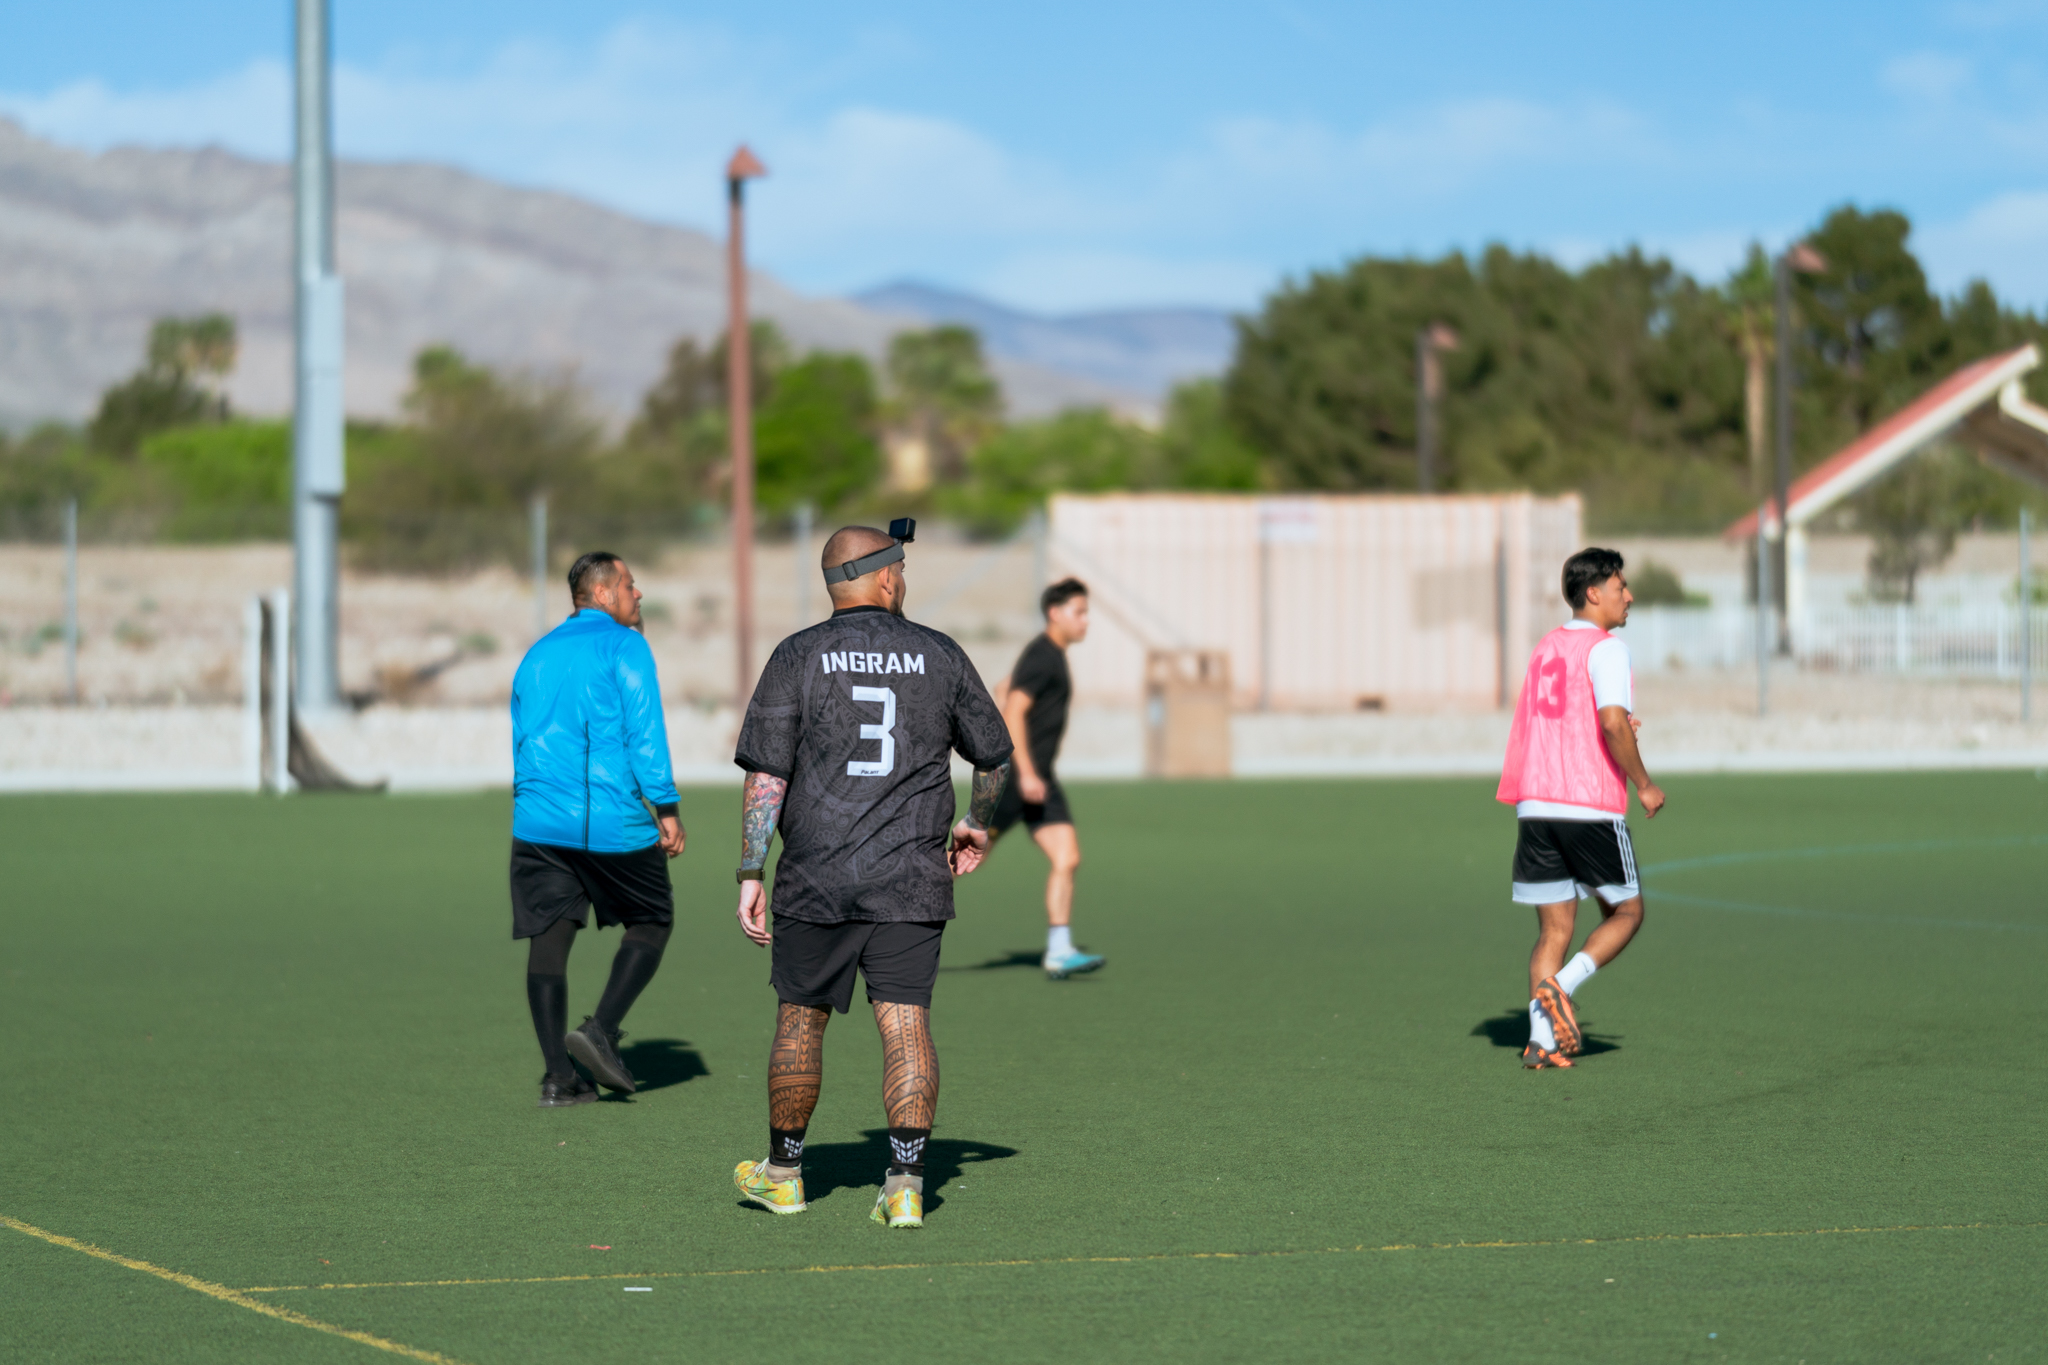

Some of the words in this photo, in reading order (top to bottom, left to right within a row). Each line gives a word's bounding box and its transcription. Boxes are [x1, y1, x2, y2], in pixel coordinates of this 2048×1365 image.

[822, 651, 925, 675] INGRAM
[1530, 655, 1567, 719] 13
[847, 686, 896, 776] 3
